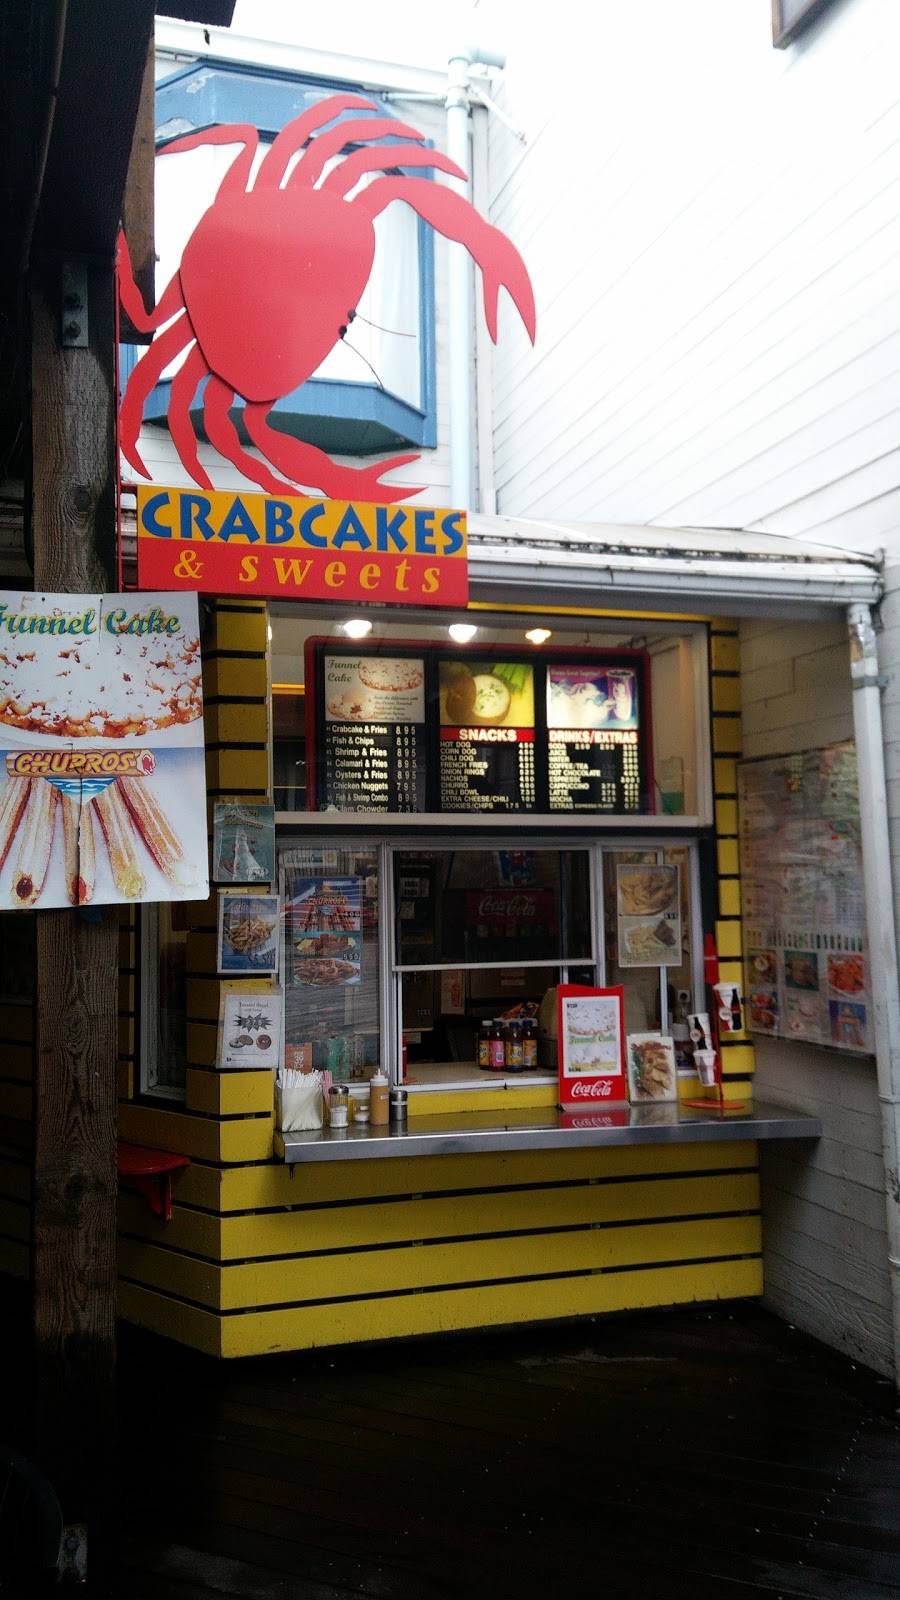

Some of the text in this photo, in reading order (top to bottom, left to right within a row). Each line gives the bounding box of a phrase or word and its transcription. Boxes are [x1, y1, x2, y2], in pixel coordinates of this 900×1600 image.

[141, 491, 466, 555] CRABCAKES
[173, 550, 441, 593] & sweets
[105, 606, 181, 635] Cake
[332, 725, 387, 734] Crabcake & Fries
[459, 729, 518, 742] SNACKS
[333, 737, 374, 746] Fish & Chips
[549, 730, 638, 744] DRINKS/EXTRAS
[335, 748, 387, 757] Shrimp & Fries
[15, 752, 138, 774] CHURROS
[365, 759, 370, 768] &
[372, 759, 388, 768] Fries
[335, 770, 388, 780] Oysters & Fries
[333, 782, 388, 792] Chicken Nuggets
[571, 1080, 614, 1097] Coca-Cola
